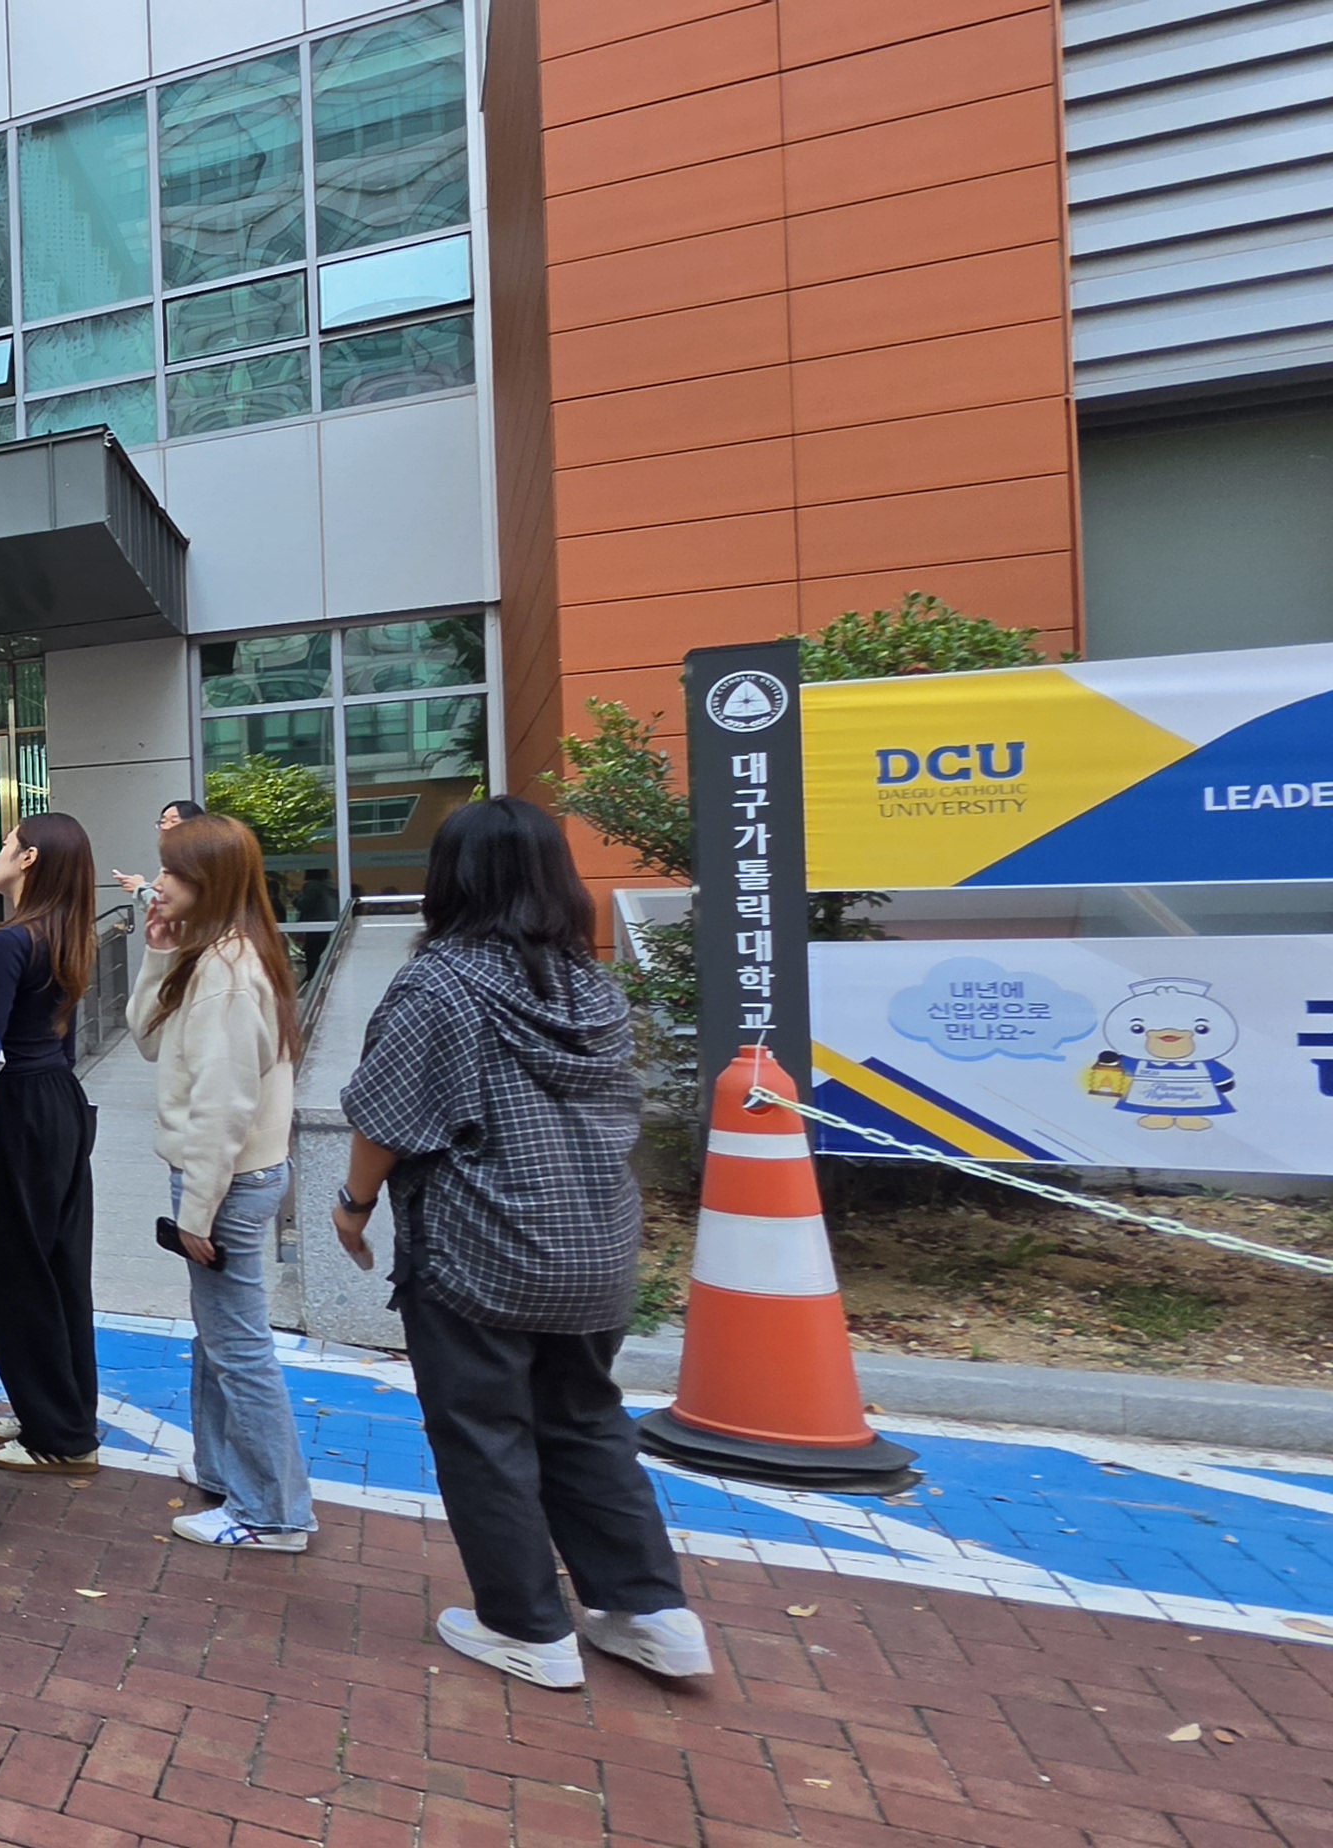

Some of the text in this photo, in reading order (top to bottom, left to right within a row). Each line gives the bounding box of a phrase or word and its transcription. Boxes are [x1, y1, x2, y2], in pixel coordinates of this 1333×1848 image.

[875, 741, 1025, 785] DCU
[878, 783, 1028, 801] DAEGU CATHOLIC
[1204, 782, 1333, 811] LEADE
[878, 799, 1028, 818] UNIVERSITY
[731, 752, 777, 1030] 대구가톨릭대학교
[950, 981, 1024, 999] 내년에
[927, 1002, 1052, 1020] 신입생으로
[944, 1023, 1035, 1041] 만나요~
